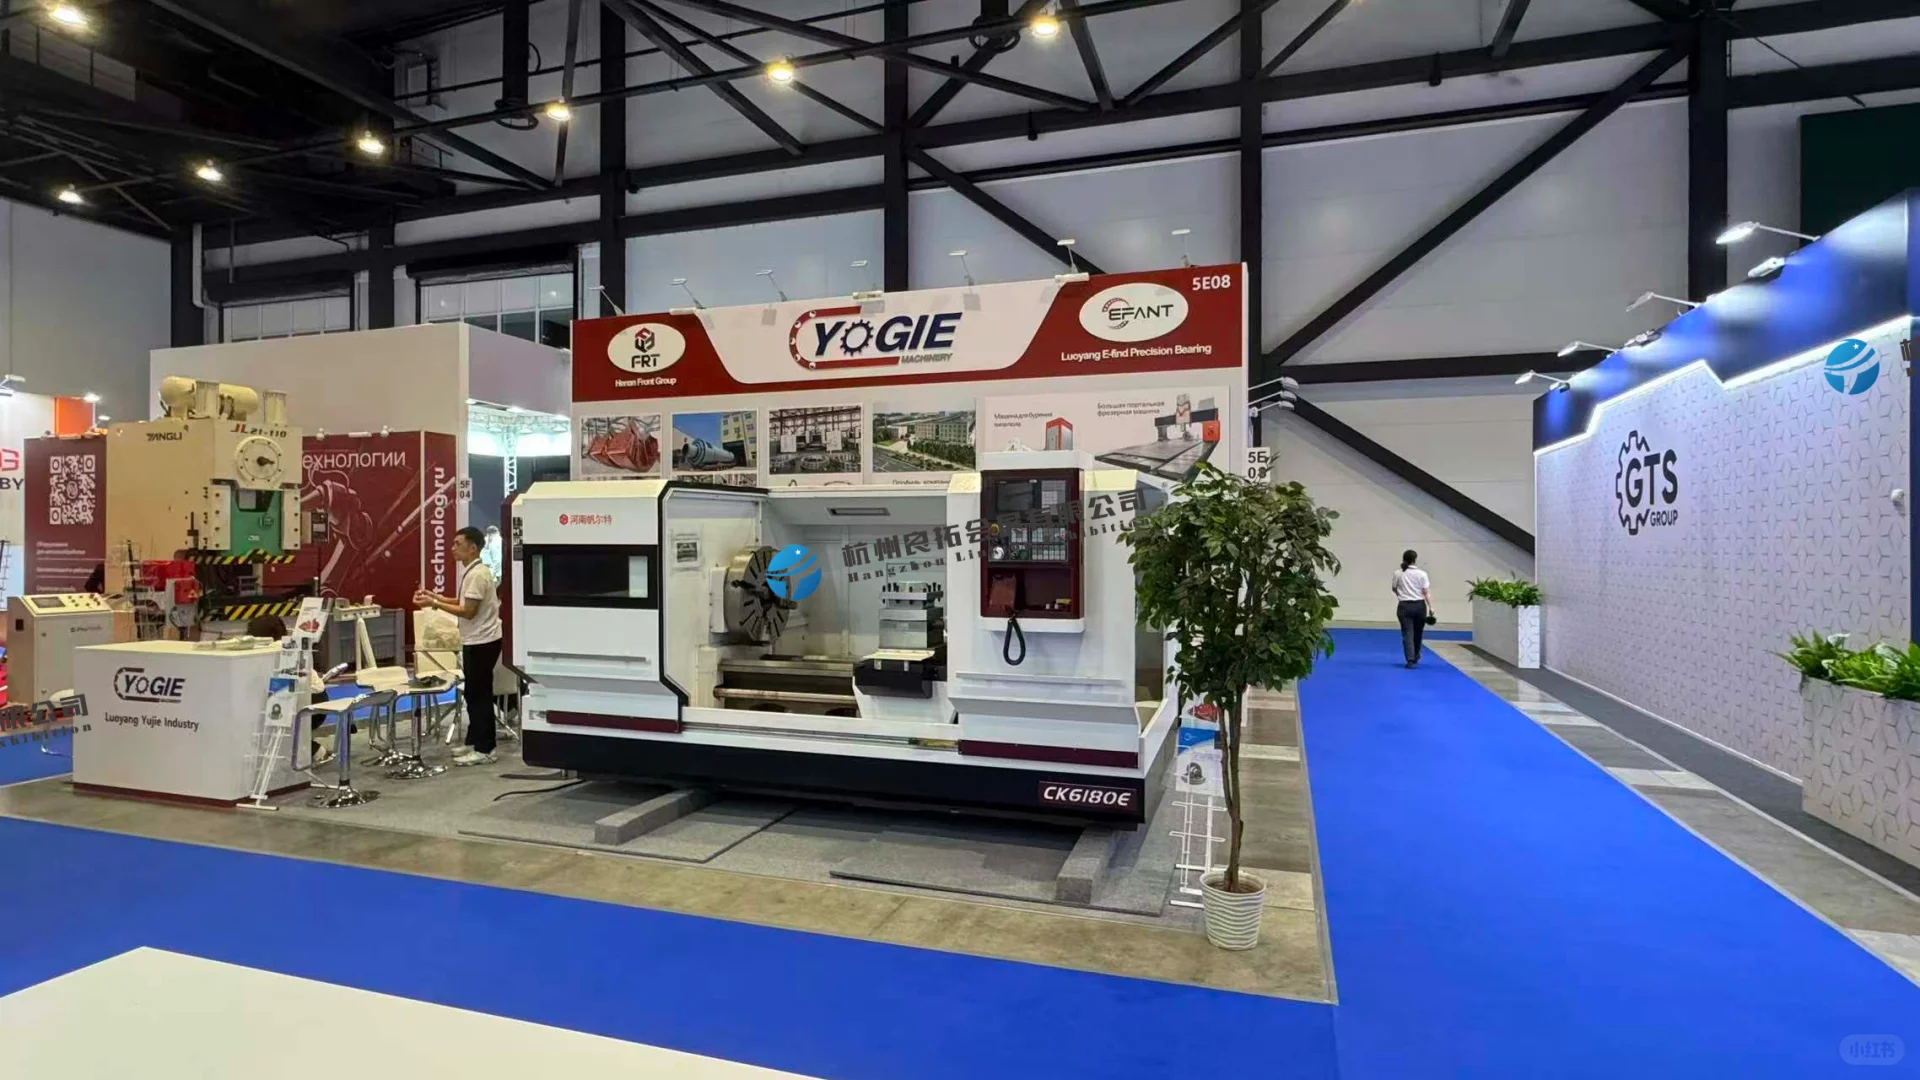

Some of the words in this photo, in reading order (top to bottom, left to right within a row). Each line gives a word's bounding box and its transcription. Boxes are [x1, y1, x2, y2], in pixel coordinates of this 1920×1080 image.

[1192, 275, 1231, 291] 5E08
[1108, 304, 1174, 321] EFANT
[814, 312, 963, 357] YOGIE
[631, 353, 661, 369] FRT
[901, 353, 953, 364] MACHINERY
[1061, 351, 1101, 362] Luoyang
[1102, 348, 1129, 359] E-find
[1130, 346, 1174, 357] Precision
[1175, 344, 1212, 355] Bearing
[615, 379, 636, 388] Henan
[636, 378, 655, 387] Front
[655, 377, 677, 386] Group
[146, 432, 182, 441] YANGLI
[302, 451, 407, 469] ехнологии
[1247, 451, 1267, 464] 5E
[460, 481, 471, 490] 5F
[1625, 449, 1678, 507] GTS
[459, 490, 471, 500] 04
[1650, 509, 1678, 526] GROUP
[125, 674, 186, 697] YOGIE
[105, 712, 139, 727] Luoyang
[141, 716, 162, 728] Yujie
[164, 717, 199, 732] Industry
[1043, 786, 1131, 806] CK6180E
